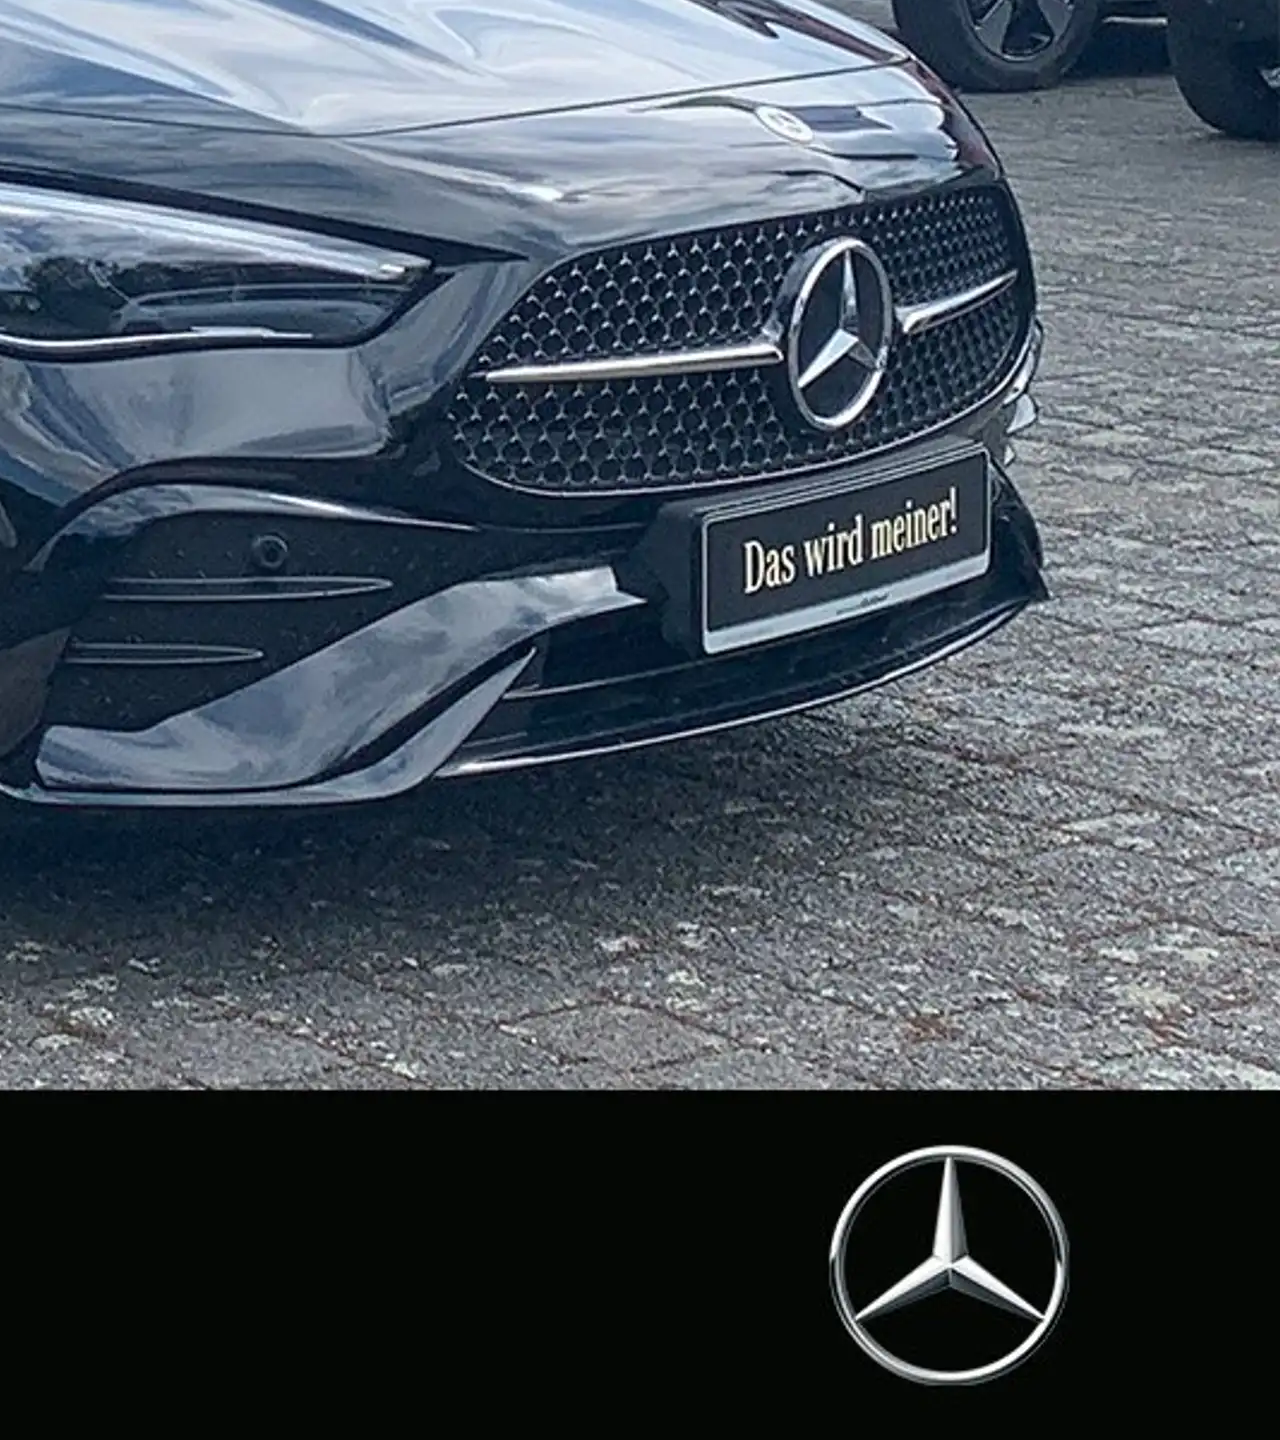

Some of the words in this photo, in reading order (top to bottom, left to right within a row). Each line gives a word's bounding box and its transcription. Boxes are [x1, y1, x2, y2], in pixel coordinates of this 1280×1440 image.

[743, 539, 795, 594] Das
[803, 513, 864, 578] wird
[870, 486, 958, 560] meiner!
